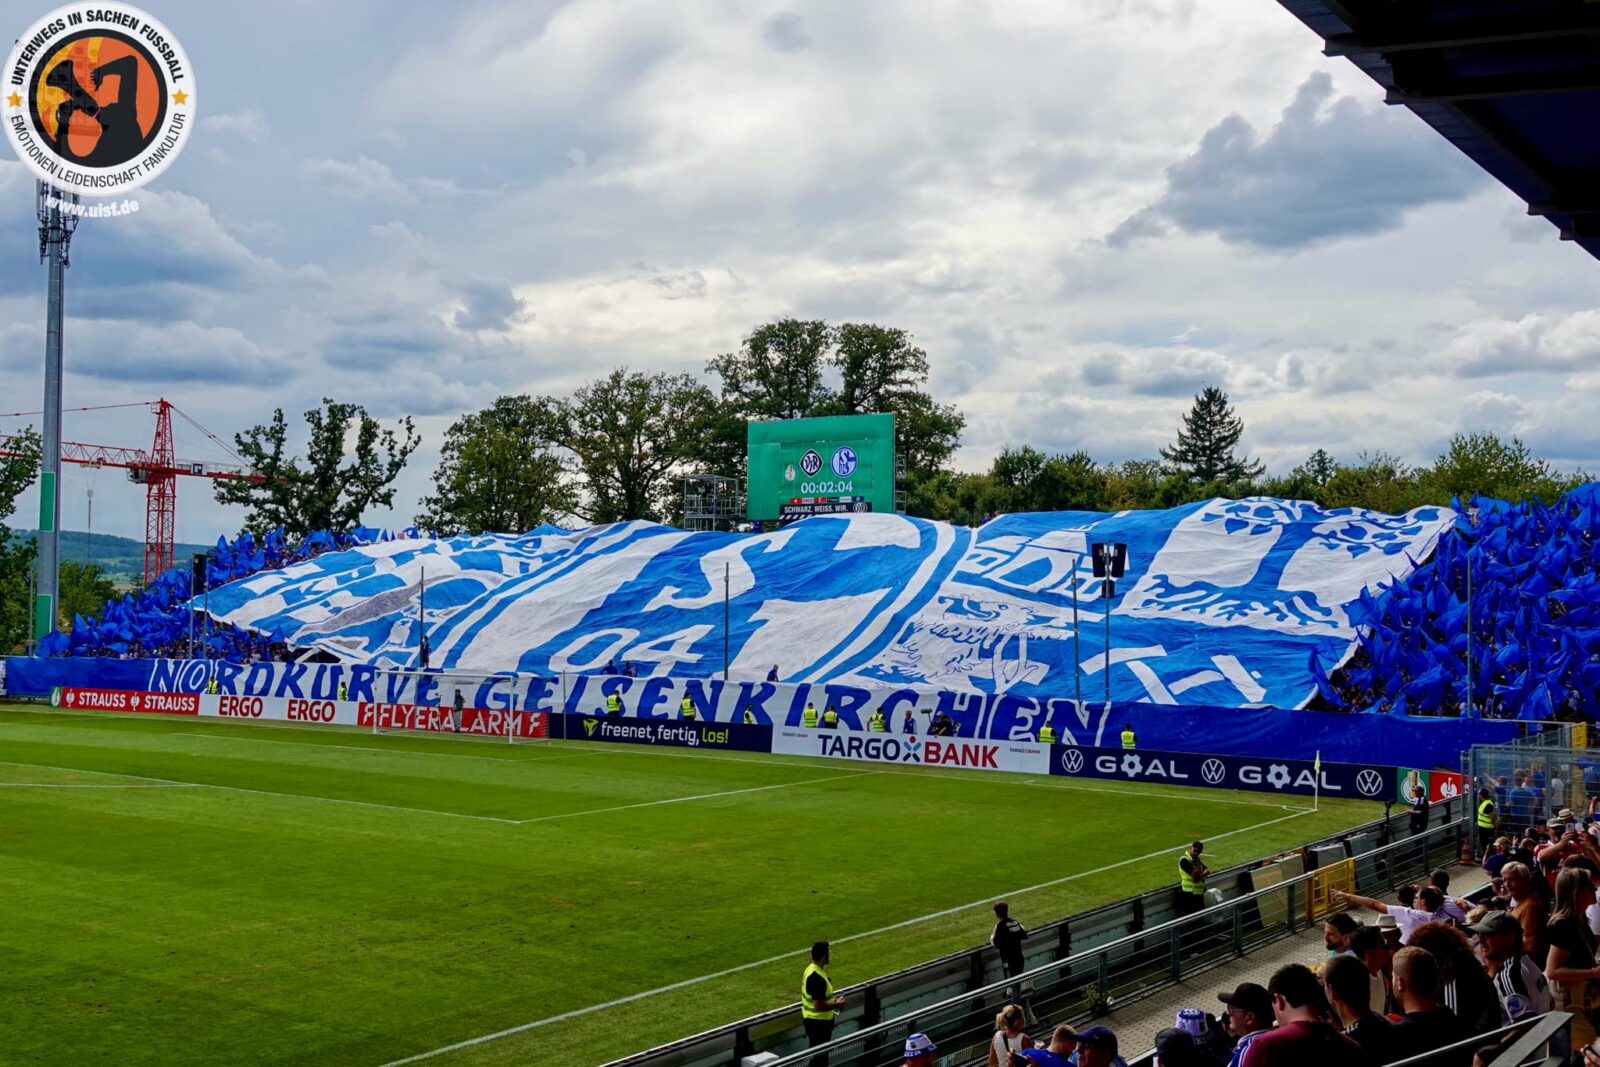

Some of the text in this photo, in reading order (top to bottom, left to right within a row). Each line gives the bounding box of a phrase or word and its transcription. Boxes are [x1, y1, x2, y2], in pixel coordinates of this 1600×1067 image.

[801, 481, 853, 494] 00:02:04
[784, 506, 814, 514] SCHWARZ.
[814, 505, 834, 513] WEISS.
[835, 504, 848, 512] WIR.
[79, 691, 195, 712] STRAUSS STRAUSS
[149, 659, 1110, 748] NORDKURVE GELSENKIRCHEN
[218, 696, 263, 718] ERGO
[287, 699, 336, 722] ERGO
[601, 722, 729, 746] freenet, fertig, los!
